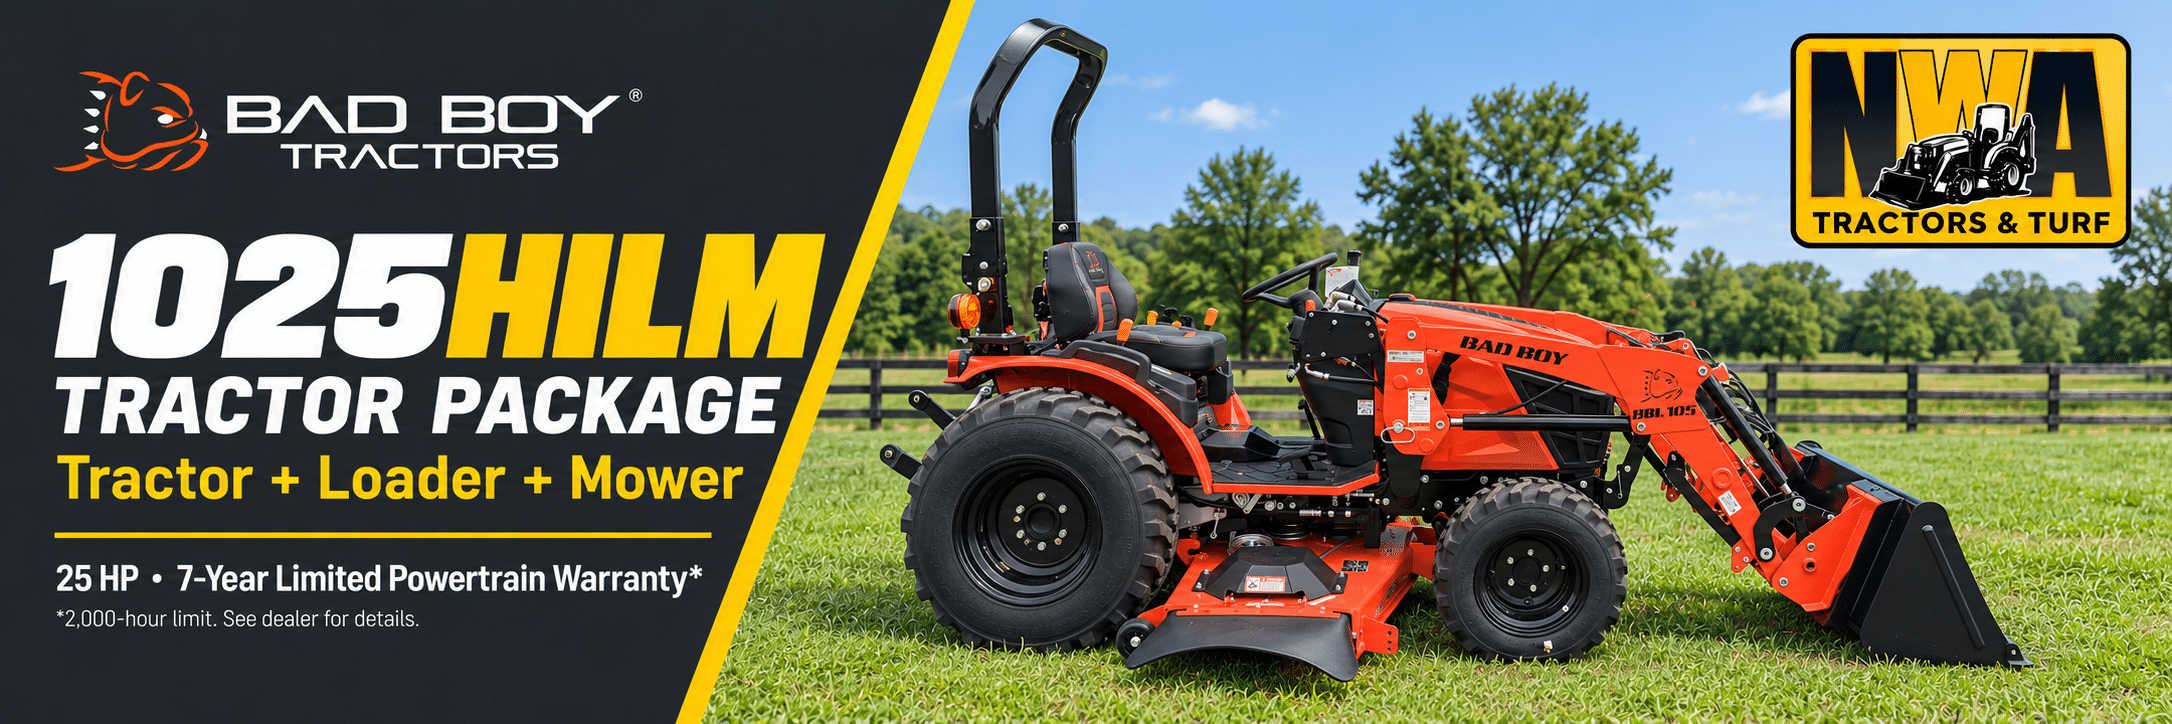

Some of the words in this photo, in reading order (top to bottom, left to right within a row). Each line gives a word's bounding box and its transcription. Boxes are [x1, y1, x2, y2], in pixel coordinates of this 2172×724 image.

[1459, 336, 1513, 356] BAD
[1516, 346, 1569, 365] BOY
[1667, 405, 1696, 417] 105
